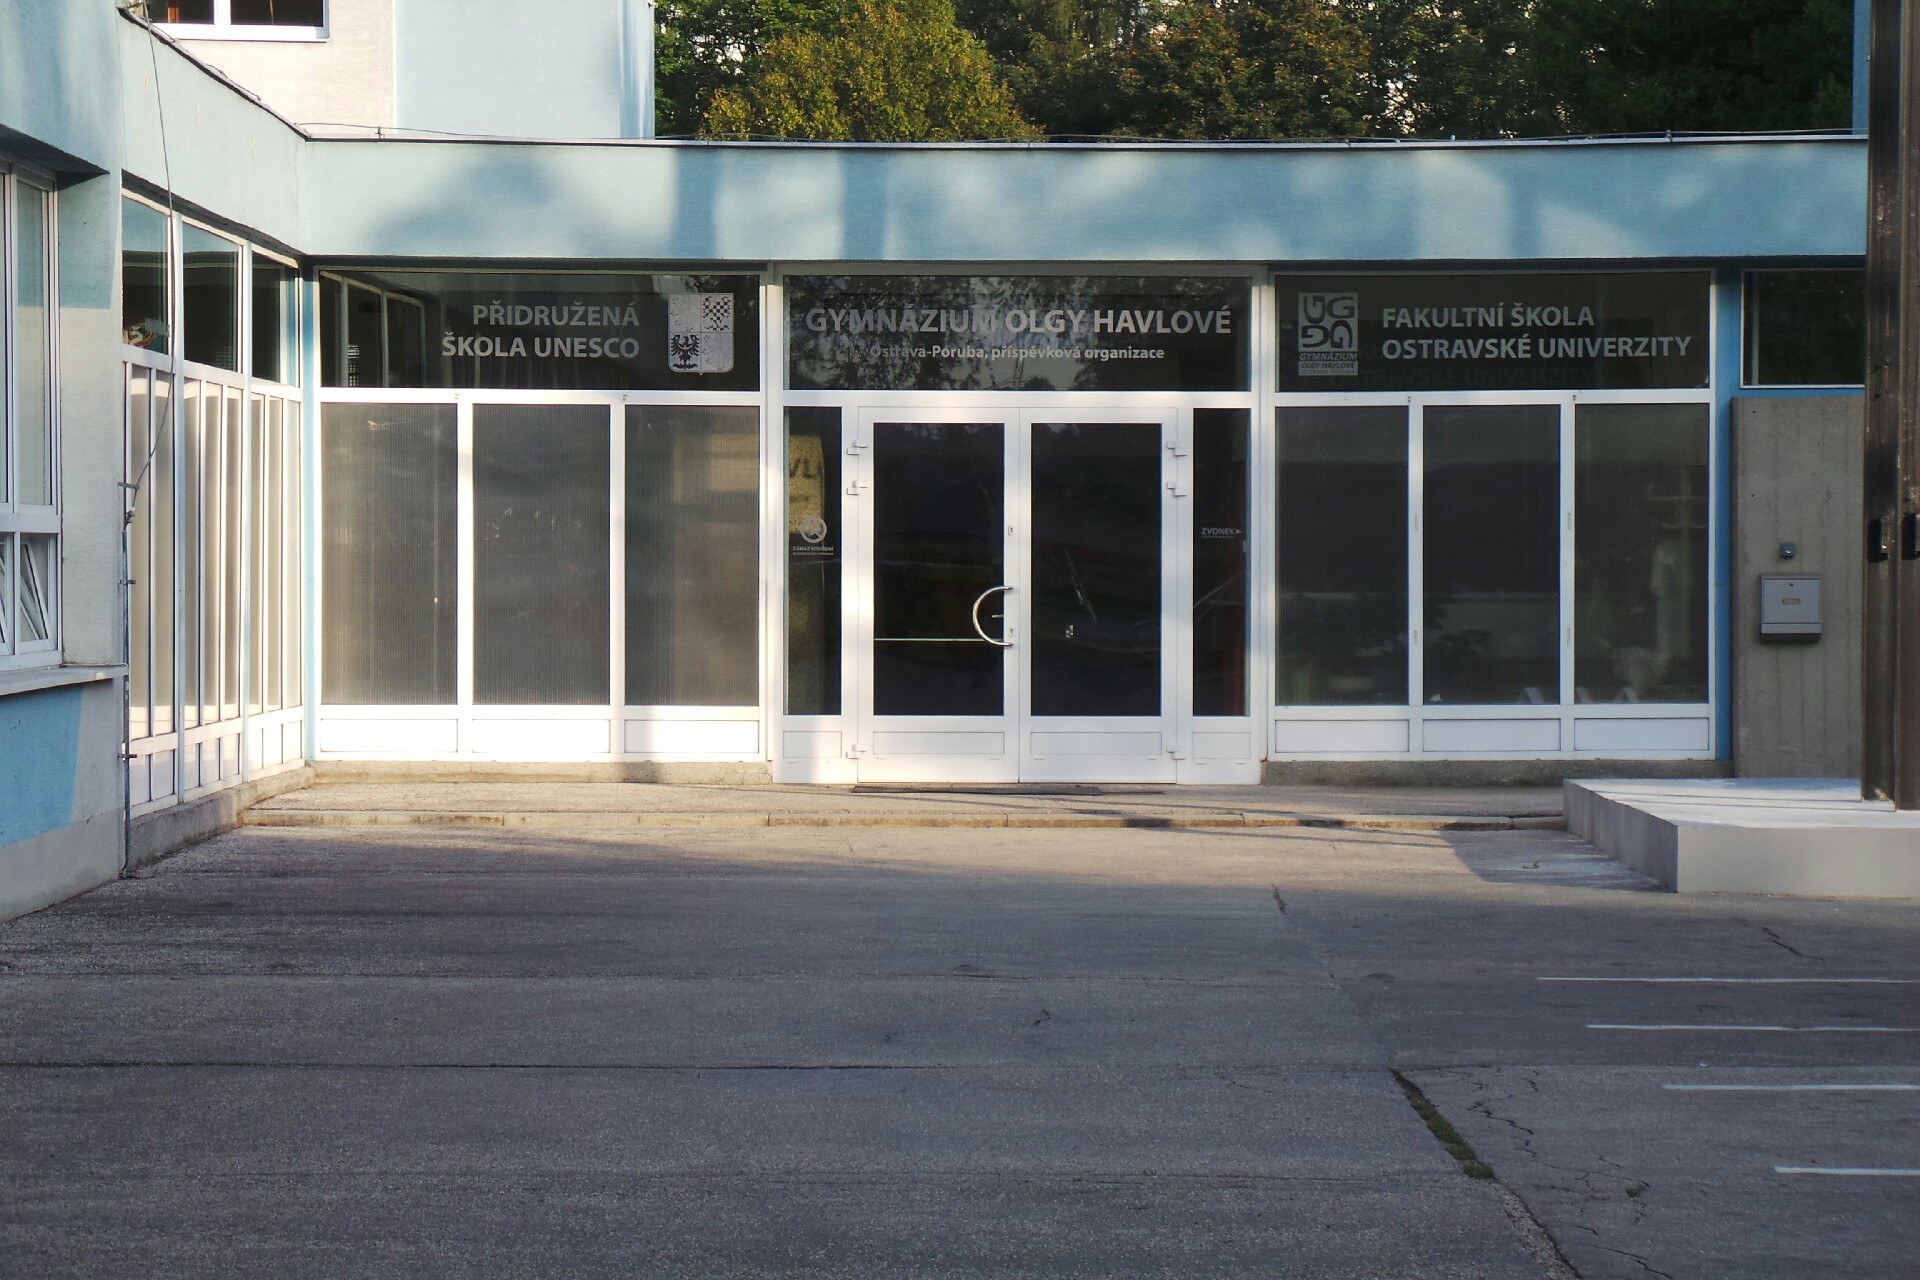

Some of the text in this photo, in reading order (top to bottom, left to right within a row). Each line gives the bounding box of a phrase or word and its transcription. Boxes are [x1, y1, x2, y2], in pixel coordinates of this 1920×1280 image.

[472, 299, 640, 326] PŘIDRUŽENÁ
[805, 303, 1231, 334] GYMNÁZIUM OLGY HAVLOVÉ
[1382, 301, 1595, 328] FAKULTNÍ ŠKOLA
[441, 331, 640, 358] ŠKOLA UNESCO
[991, 345, 1081, 363] příspěvková
[1085, 345, 1165, 362] organizace
[1382, 333, 1692, 360] OSTRAVSKÉ UNIVERZITY
[1201, 527, 1235, 535] ZVONEK
